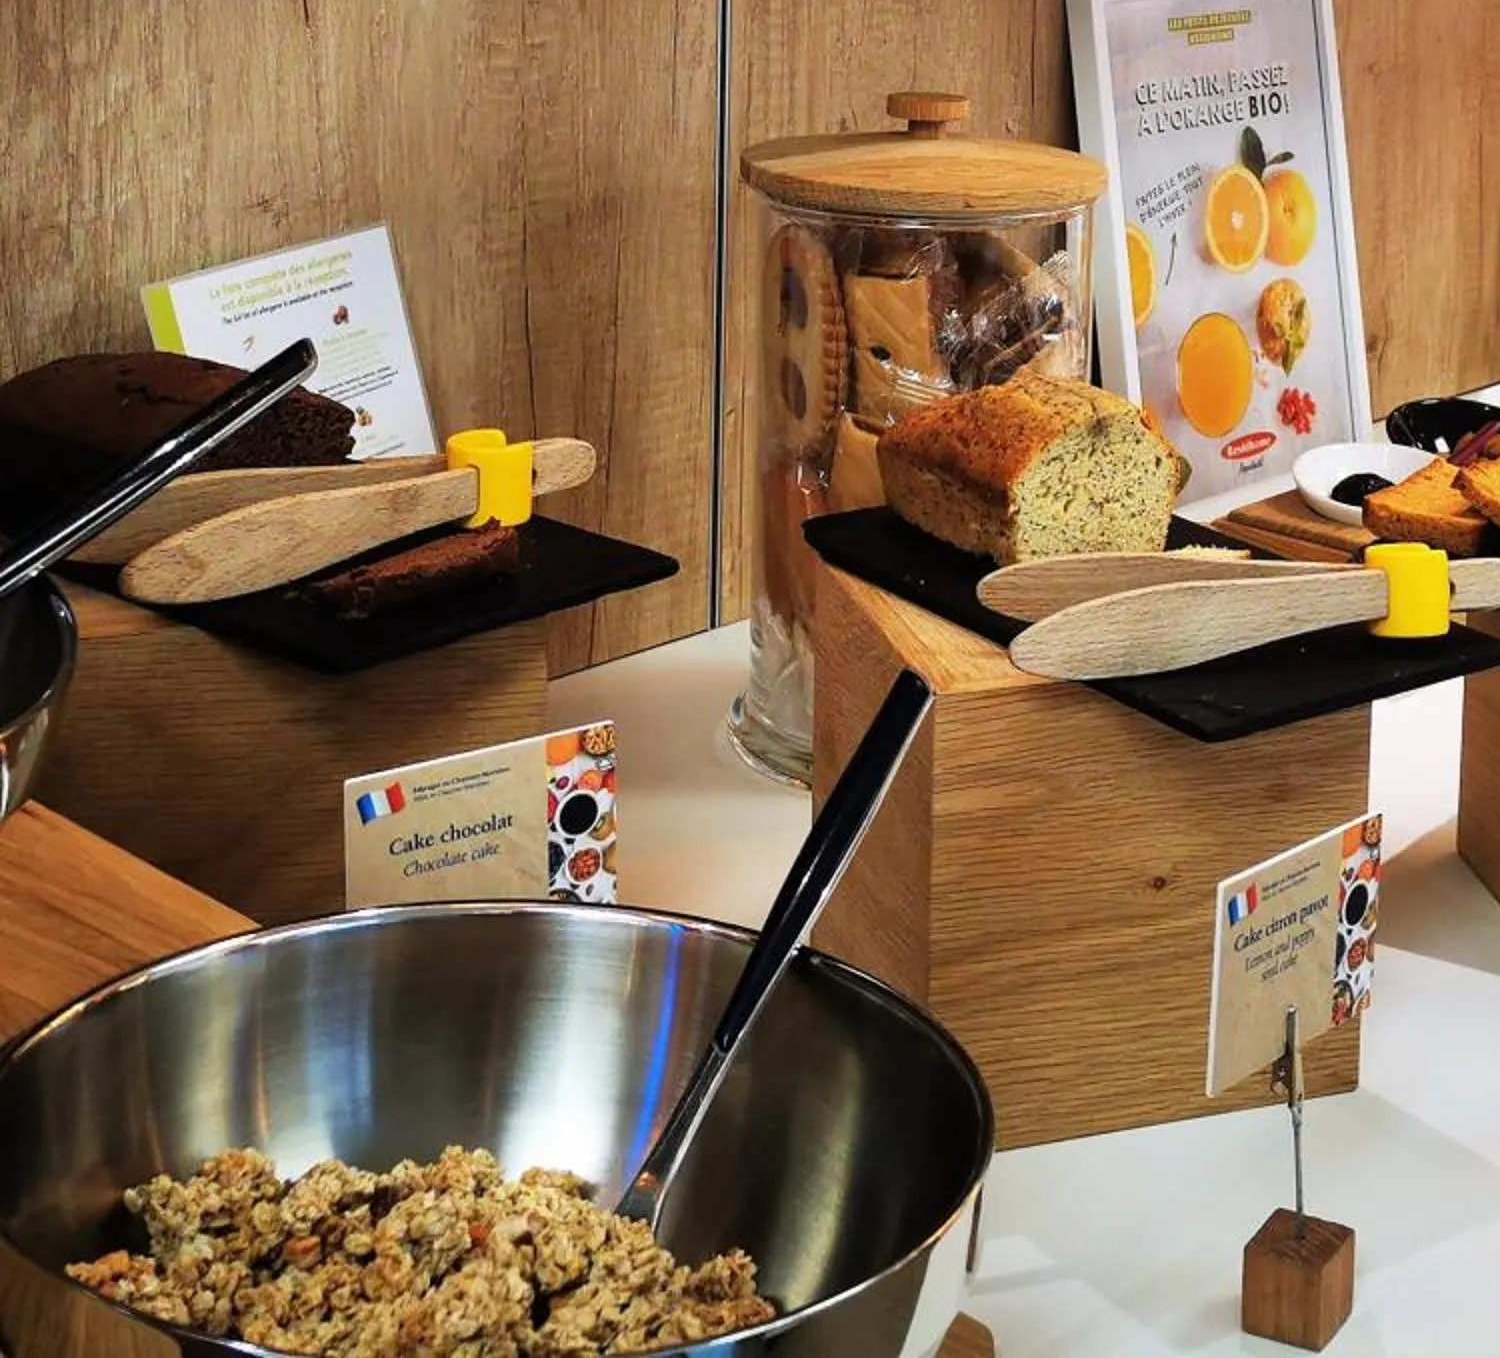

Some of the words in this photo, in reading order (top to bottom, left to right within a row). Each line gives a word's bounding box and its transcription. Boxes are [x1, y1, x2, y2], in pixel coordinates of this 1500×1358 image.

[1135, 82, 1157, 106] CE
[1162, 72, 1225, 104] MATIN,
[1227, 65, 1289, 93] PASSEZ
[1165, 178, 1176, 190] LE
[389, 831, 435, 856] Cake
[440, 813, 513, 844] chocolat
[402, 847, 467, 879] Chocolate
[470, 841, 499, 863] cake
[1234, 925, 1263, 952] Cake
[1265, 909, 1297, 938] citron
[1299, 894, 1329, 925] pavot
[1245, 945, 1273, 974] Lemon
[1273, 937, 1290, 958] and
